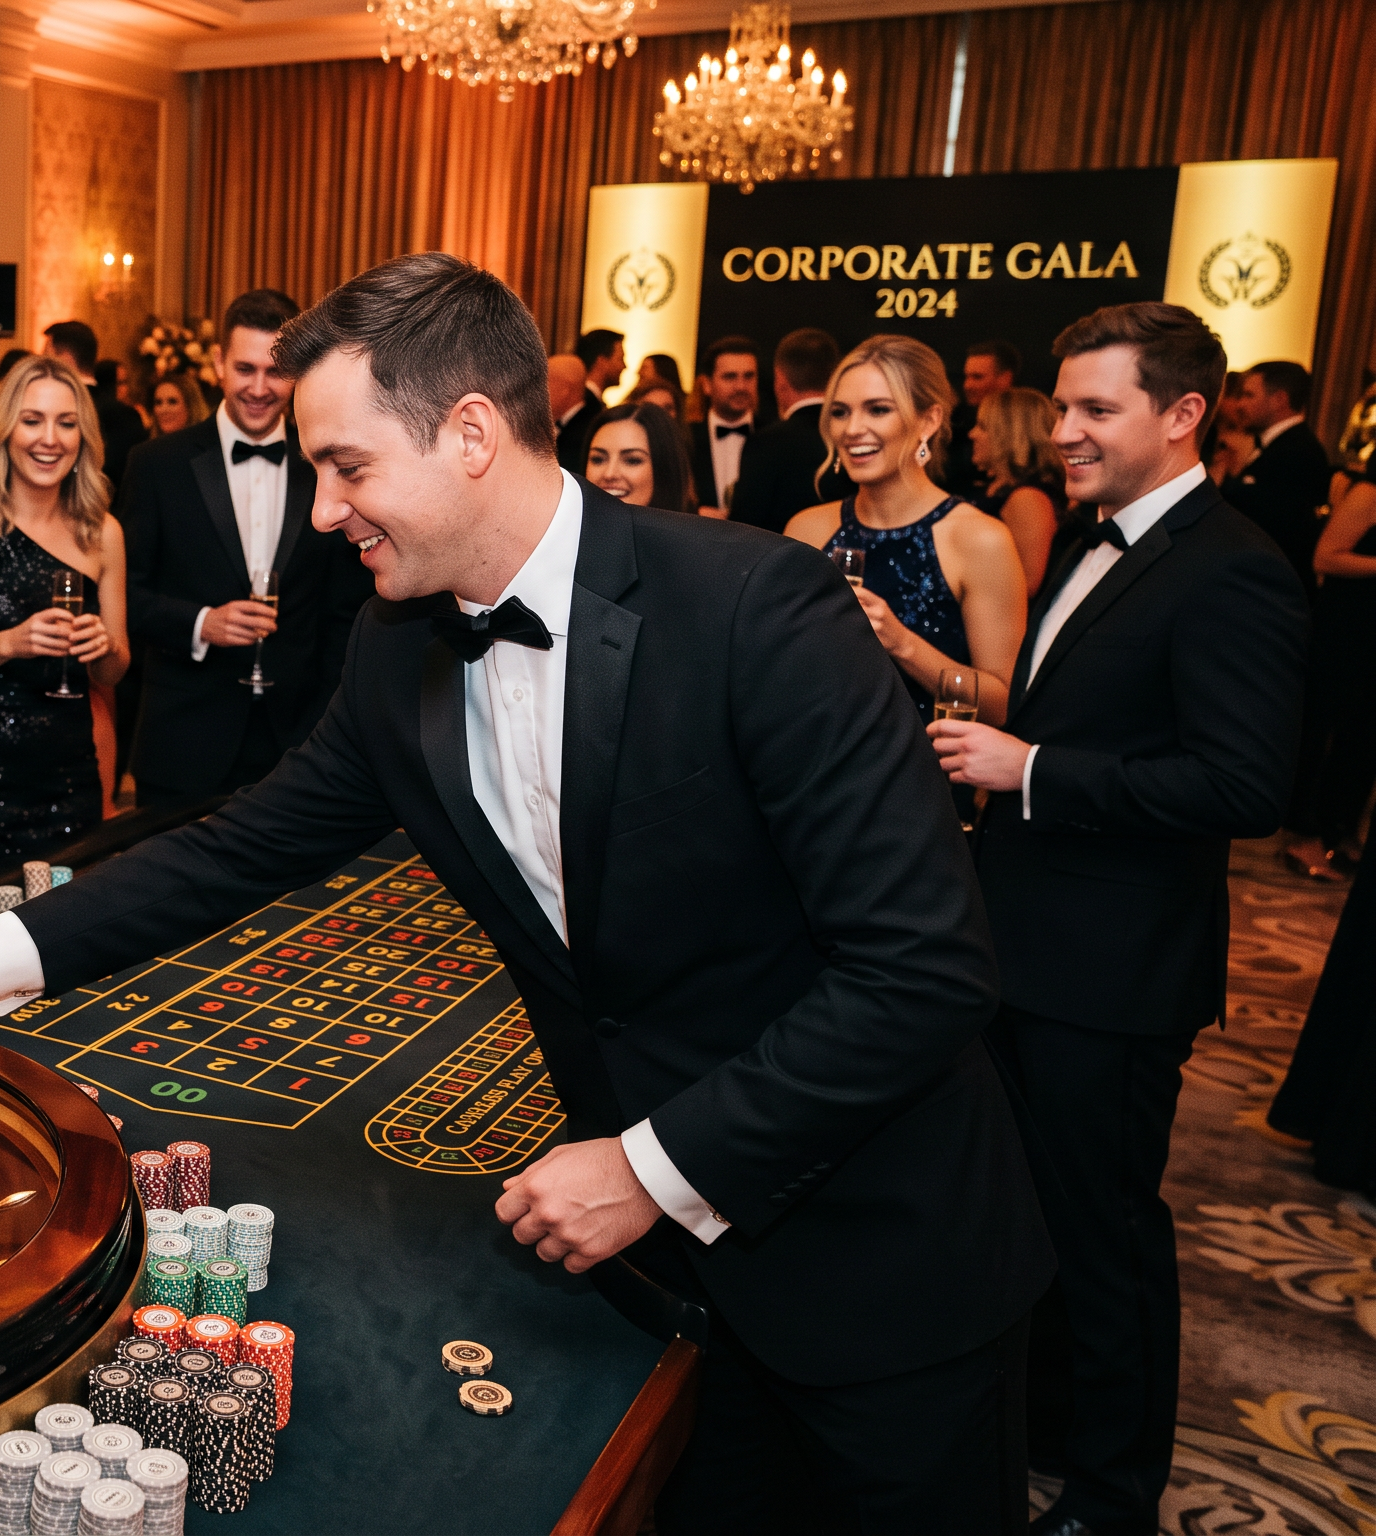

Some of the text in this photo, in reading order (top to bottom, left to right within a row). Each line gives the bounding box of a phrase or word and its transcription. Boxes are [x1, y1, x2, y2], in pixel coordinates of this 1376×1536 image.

[722, 240, 1140, 282] CORPORATE GALA
[875, 287, 959, 318] 2024
[149, 1081, 208, 1103] 00
